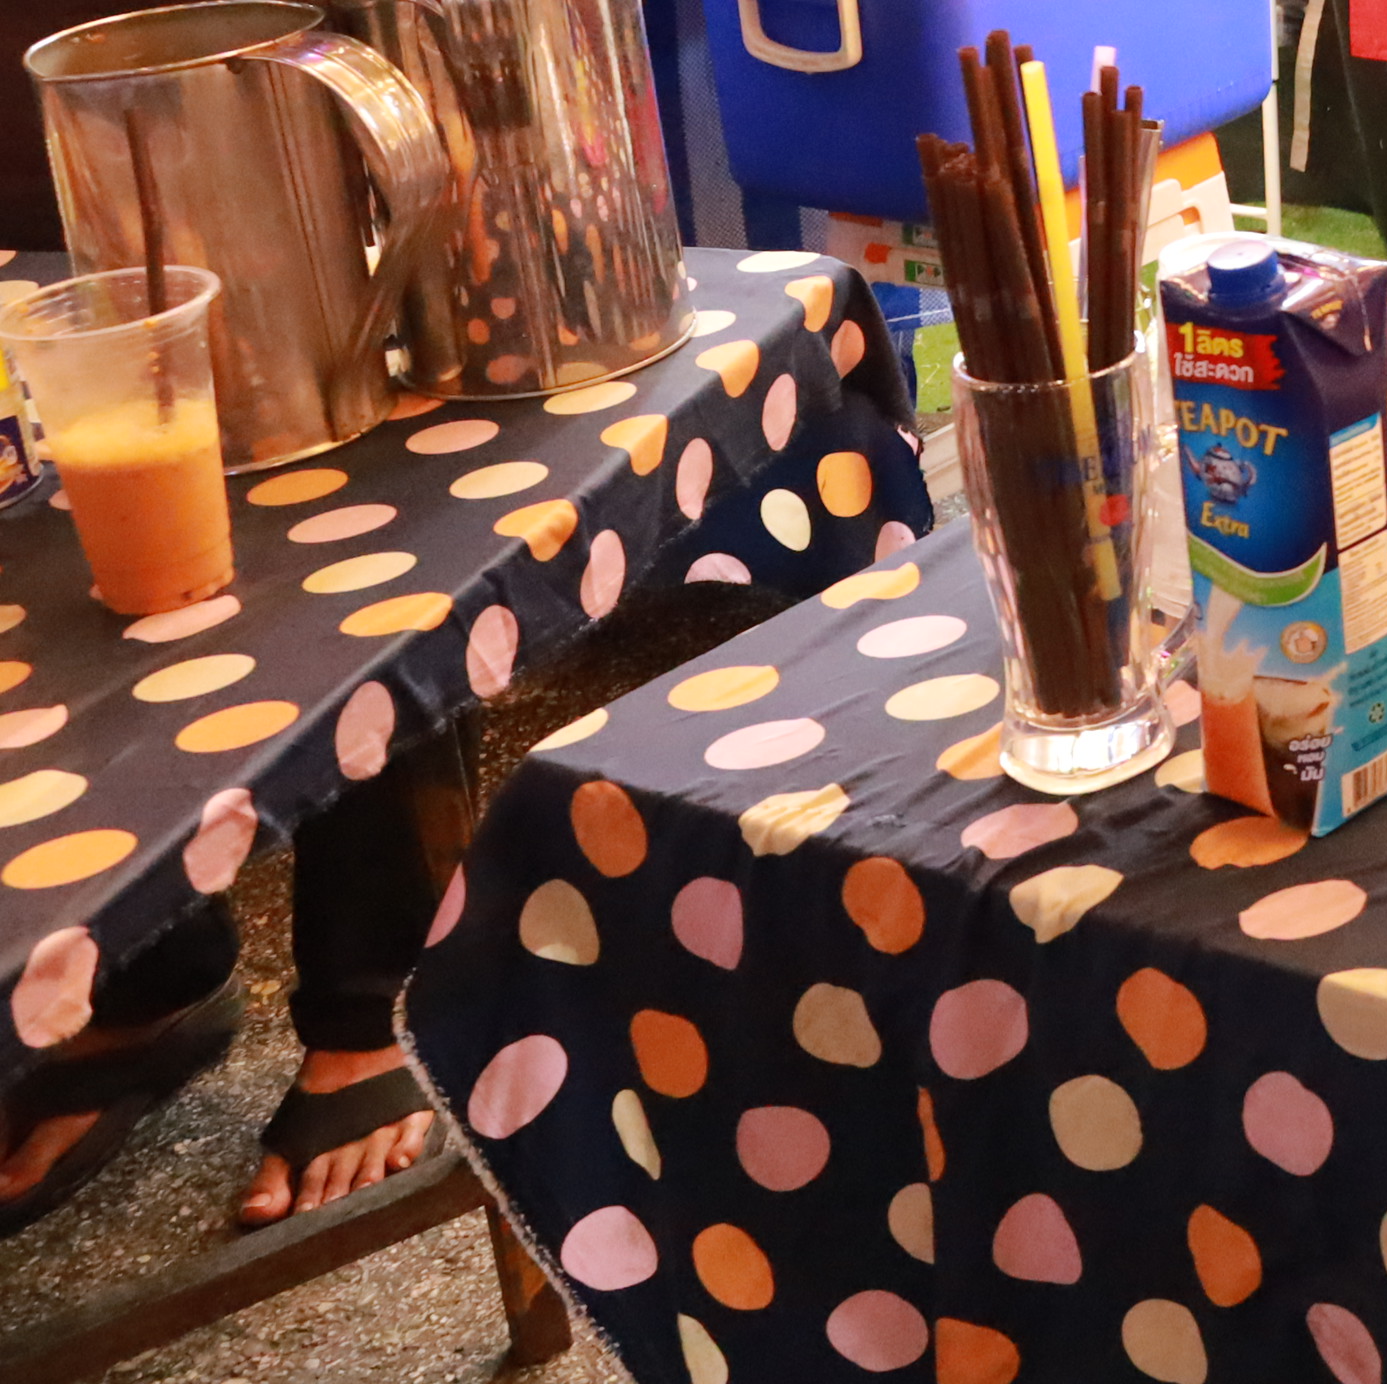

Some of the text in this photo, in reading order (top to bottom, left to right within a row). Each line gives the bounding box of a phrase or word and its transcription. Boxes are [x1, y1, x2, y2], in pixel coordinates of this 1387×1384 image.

[1173, 353, 1255, 383] ใช้สะดวก
[1201, 501, 1251, 538] Extra
